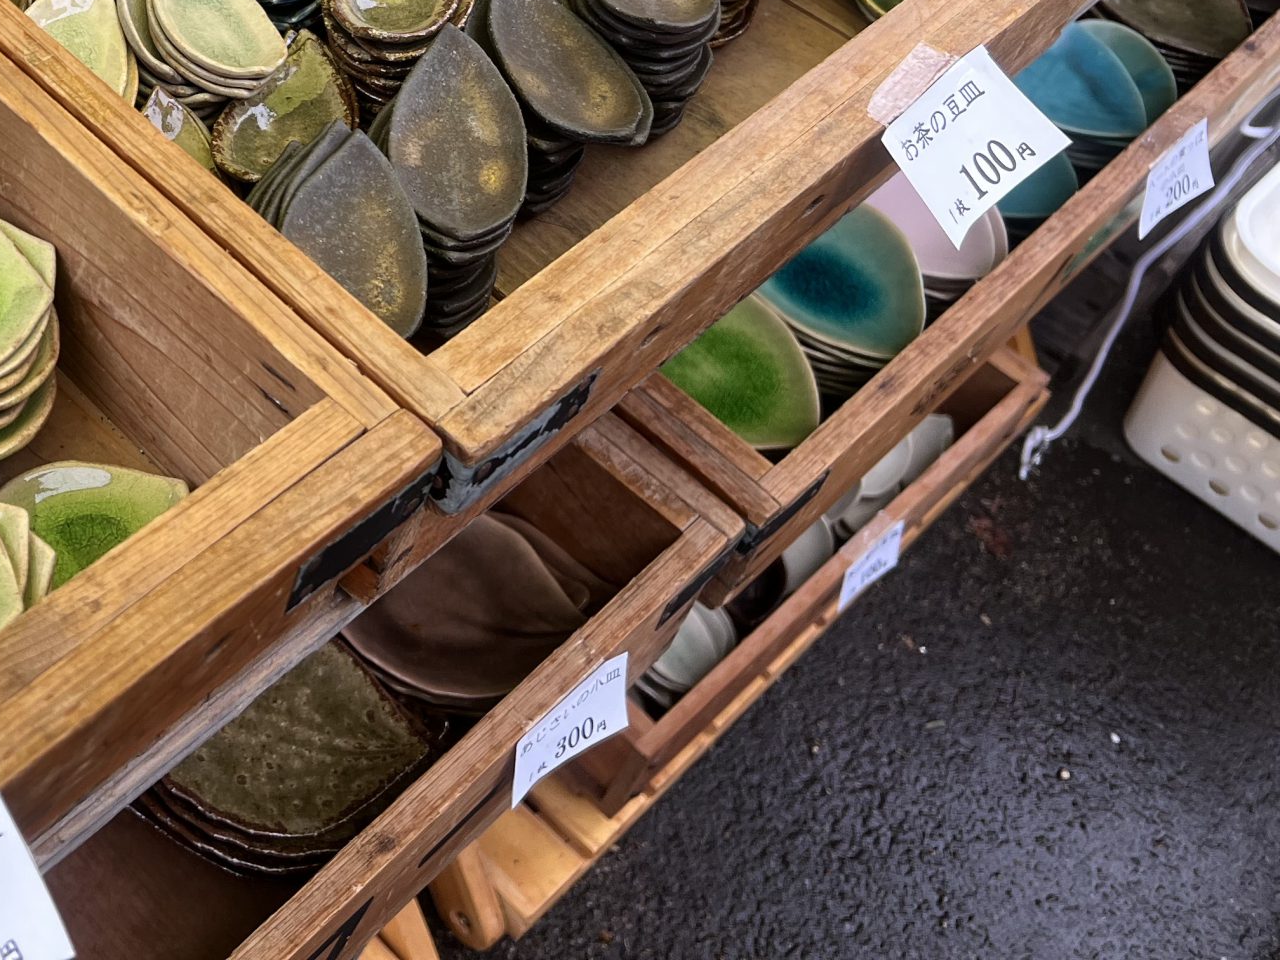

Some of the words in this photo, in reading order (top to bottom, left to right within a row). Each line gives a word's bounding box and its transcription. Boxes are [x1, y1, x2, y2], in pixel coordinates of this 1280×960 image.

[901, 80, 985, 161] お茶の豆皿
[959, 139, 1036, 200] 100円
[520, 667, 621, 757] あじさいの小皿
[554, 716, 607, 759] 300円
